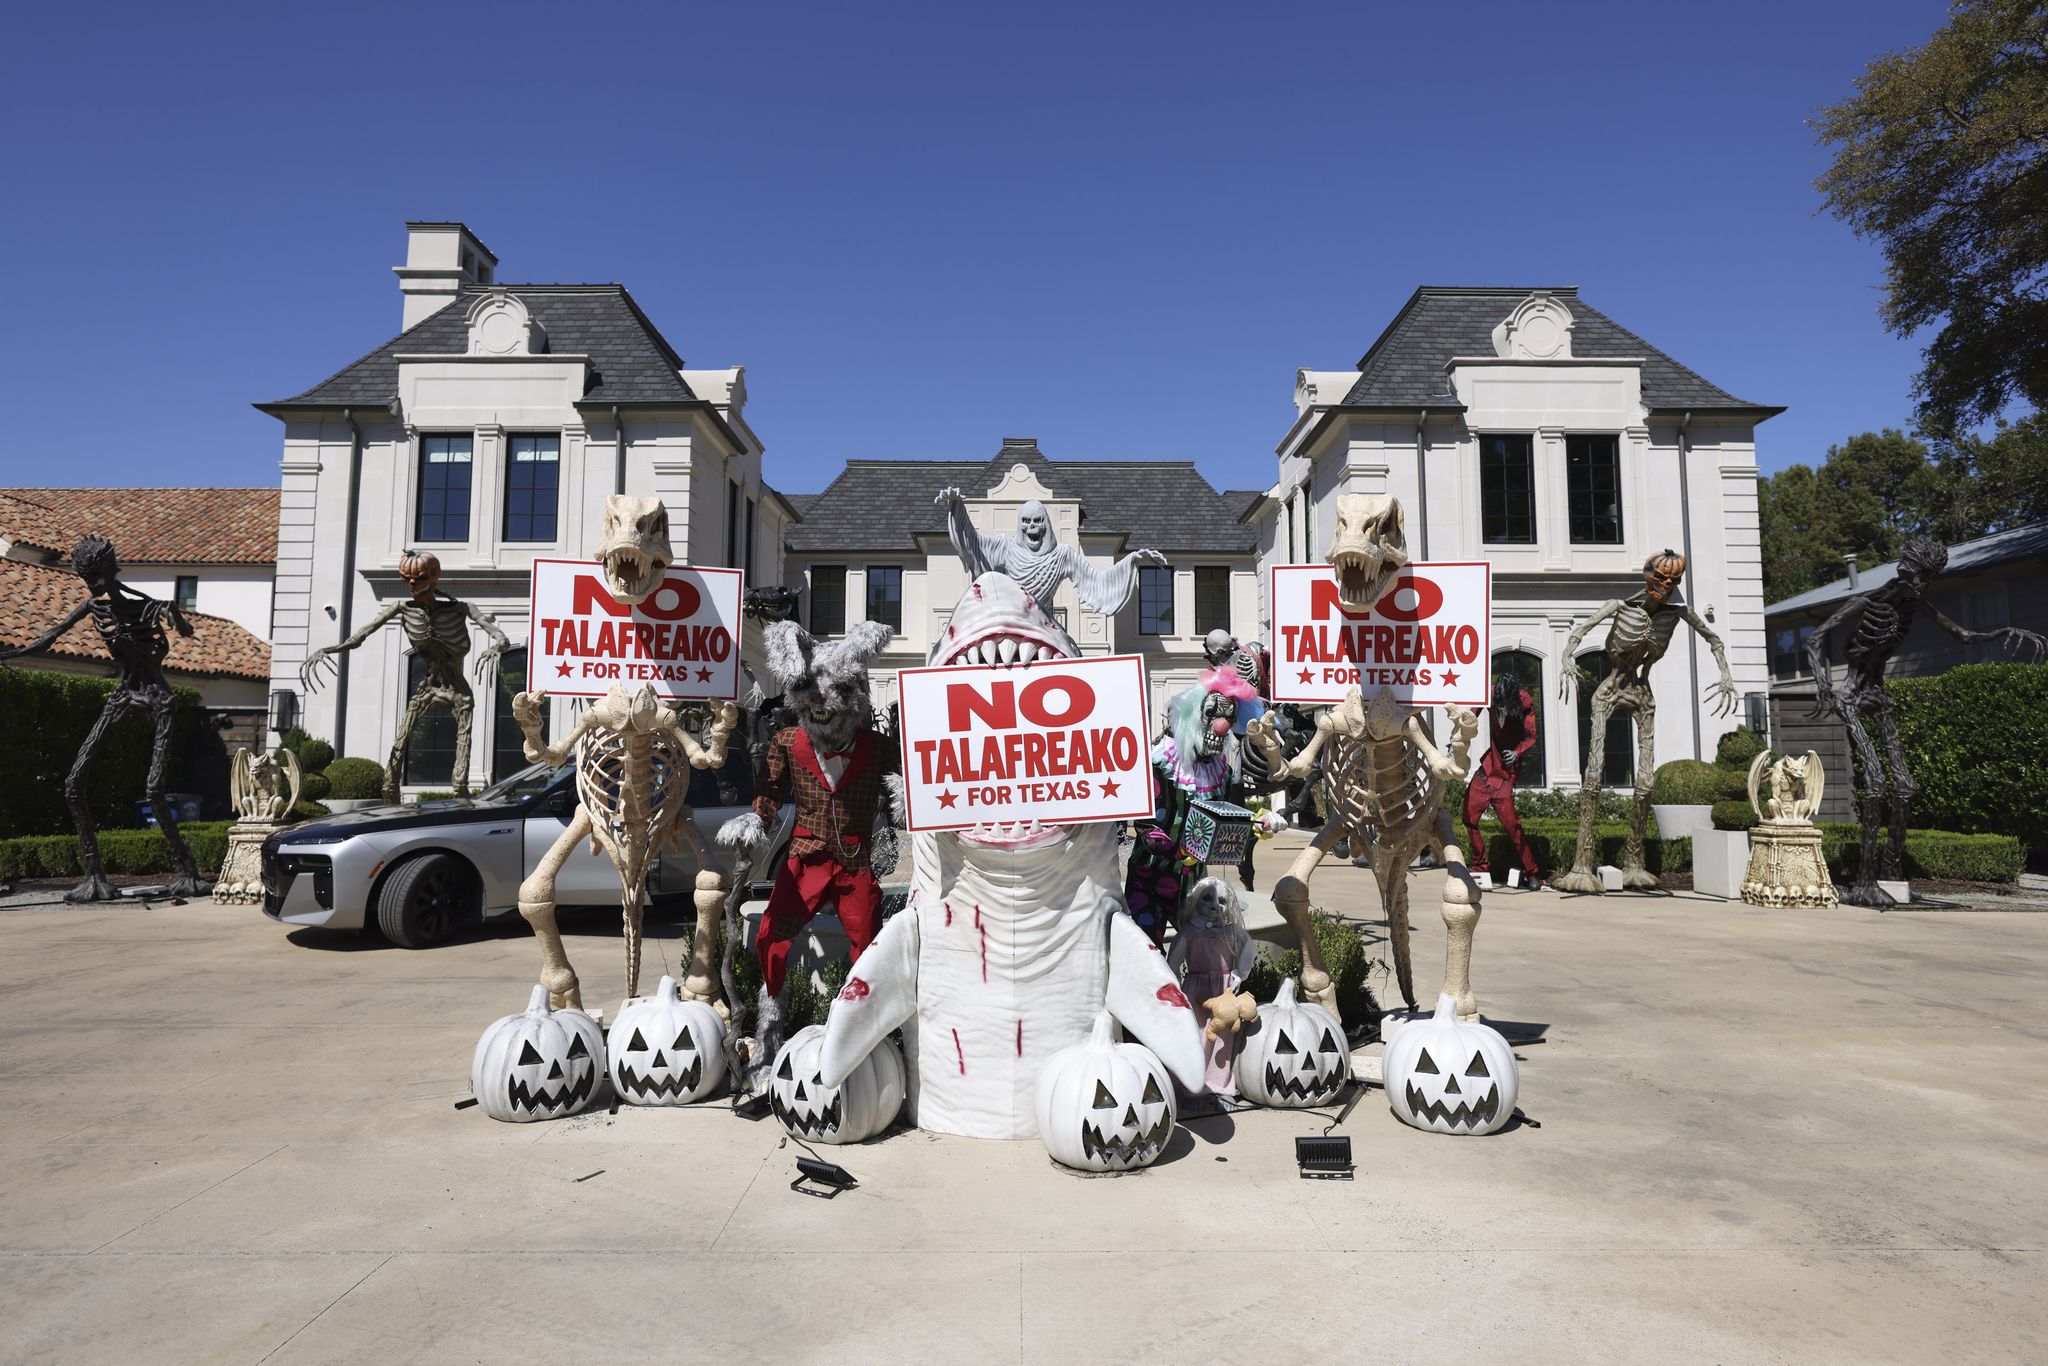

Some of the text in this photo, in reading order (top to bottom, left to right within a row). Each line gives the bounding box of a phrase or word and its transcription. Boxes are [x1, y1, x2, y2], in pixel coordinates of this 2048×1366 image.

[573, 574, 701, 621] NO
[541, 618, 731, 663] TALAFREAKO
[1281, 624, 1480, 665] TALAFREAKO
[582, 661, 688, 682] FOR TEXAS
[1323, 667, 1432, 686] FOR TEXAS
[946, 674, 1096, 733] NO
[914, 726, 1138, 785] TALAFREAKO
[967, 779, 1091, 807] FOR TEXAS
[1219, 832, 1245, 842] JACK'S
[1220, 845, 1238, 853] BOX
